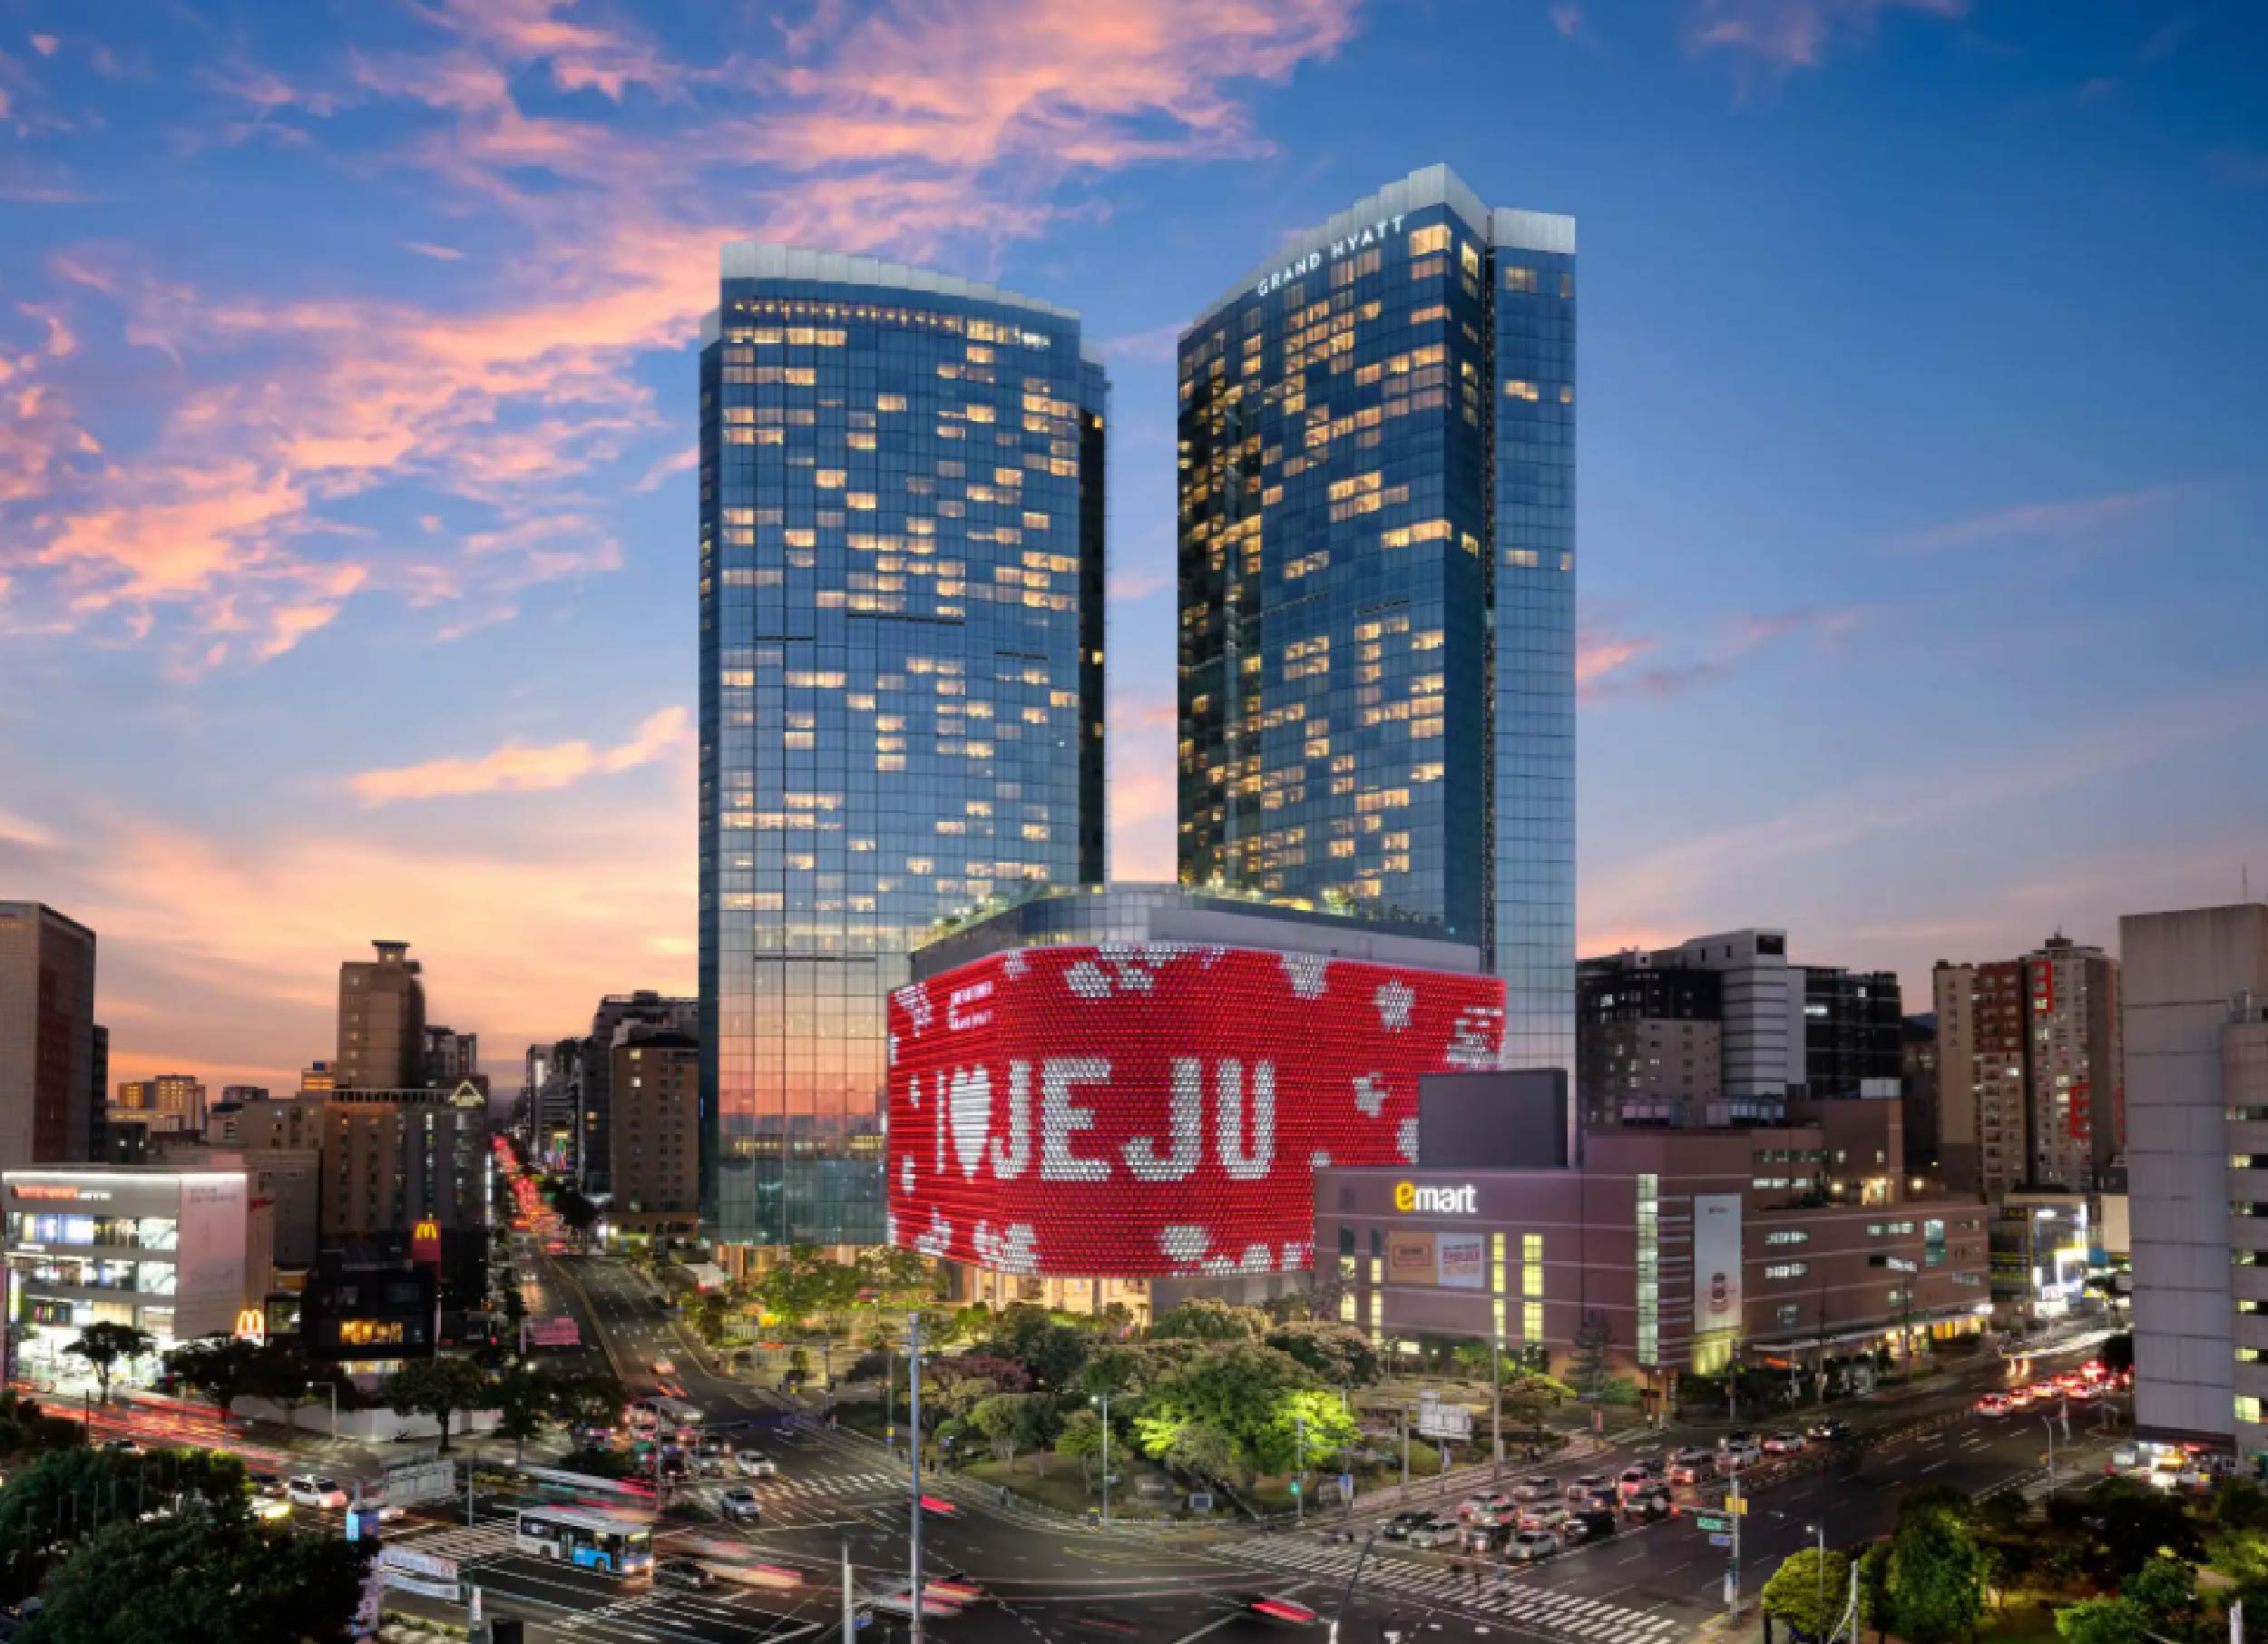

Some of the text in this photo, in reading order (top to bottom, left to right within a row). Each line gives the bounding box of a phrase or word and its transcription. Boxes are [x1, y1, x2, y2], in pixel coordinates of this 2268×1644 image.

[1257, 215, 1404, 297] GRAND HYATT
[992, 1058, 1275, 1181] JEJU
[1395, 1182, 1478, 1213] emart
